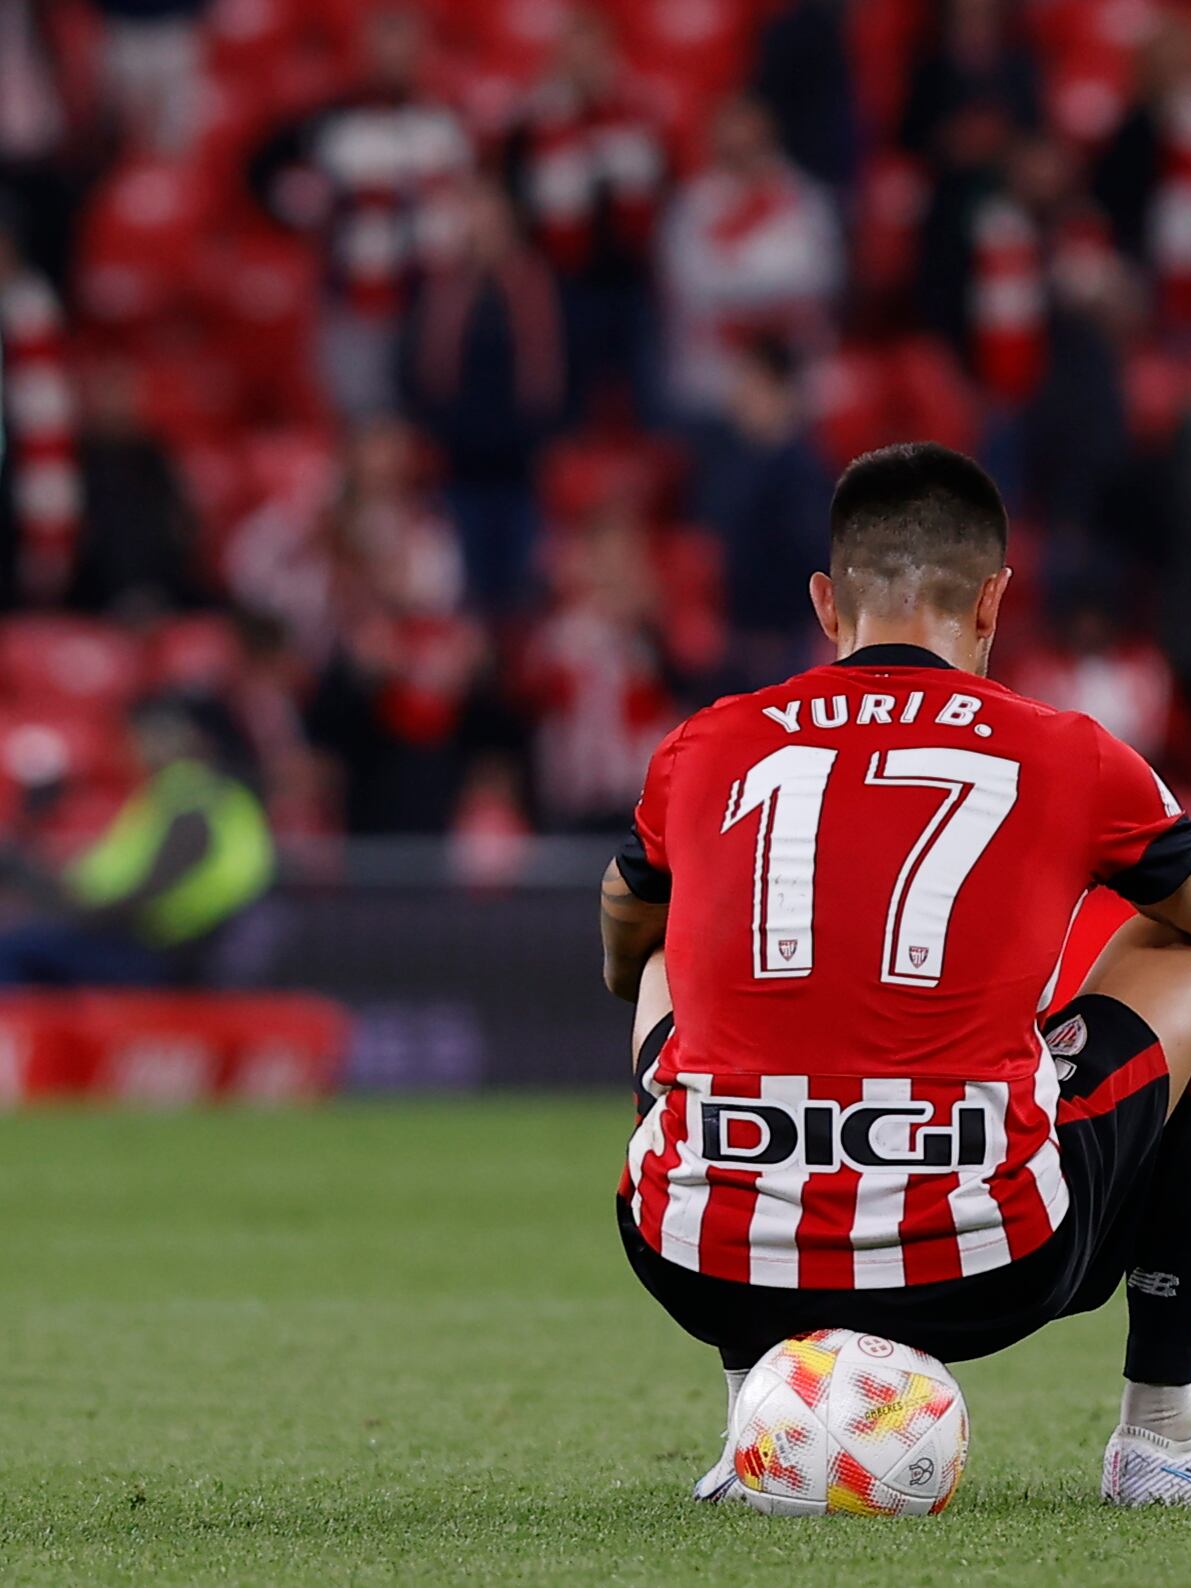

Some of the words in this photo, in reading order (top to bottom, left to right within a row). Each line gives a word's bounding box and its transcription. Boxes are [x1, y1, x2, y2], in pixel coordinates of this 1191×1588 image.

[762, 691, 925, 733] YURI
[934, 693, 993, 738] B.
[720, 744, 1021, 988] 17
[699, 1100, 988, 1169] DIGI
